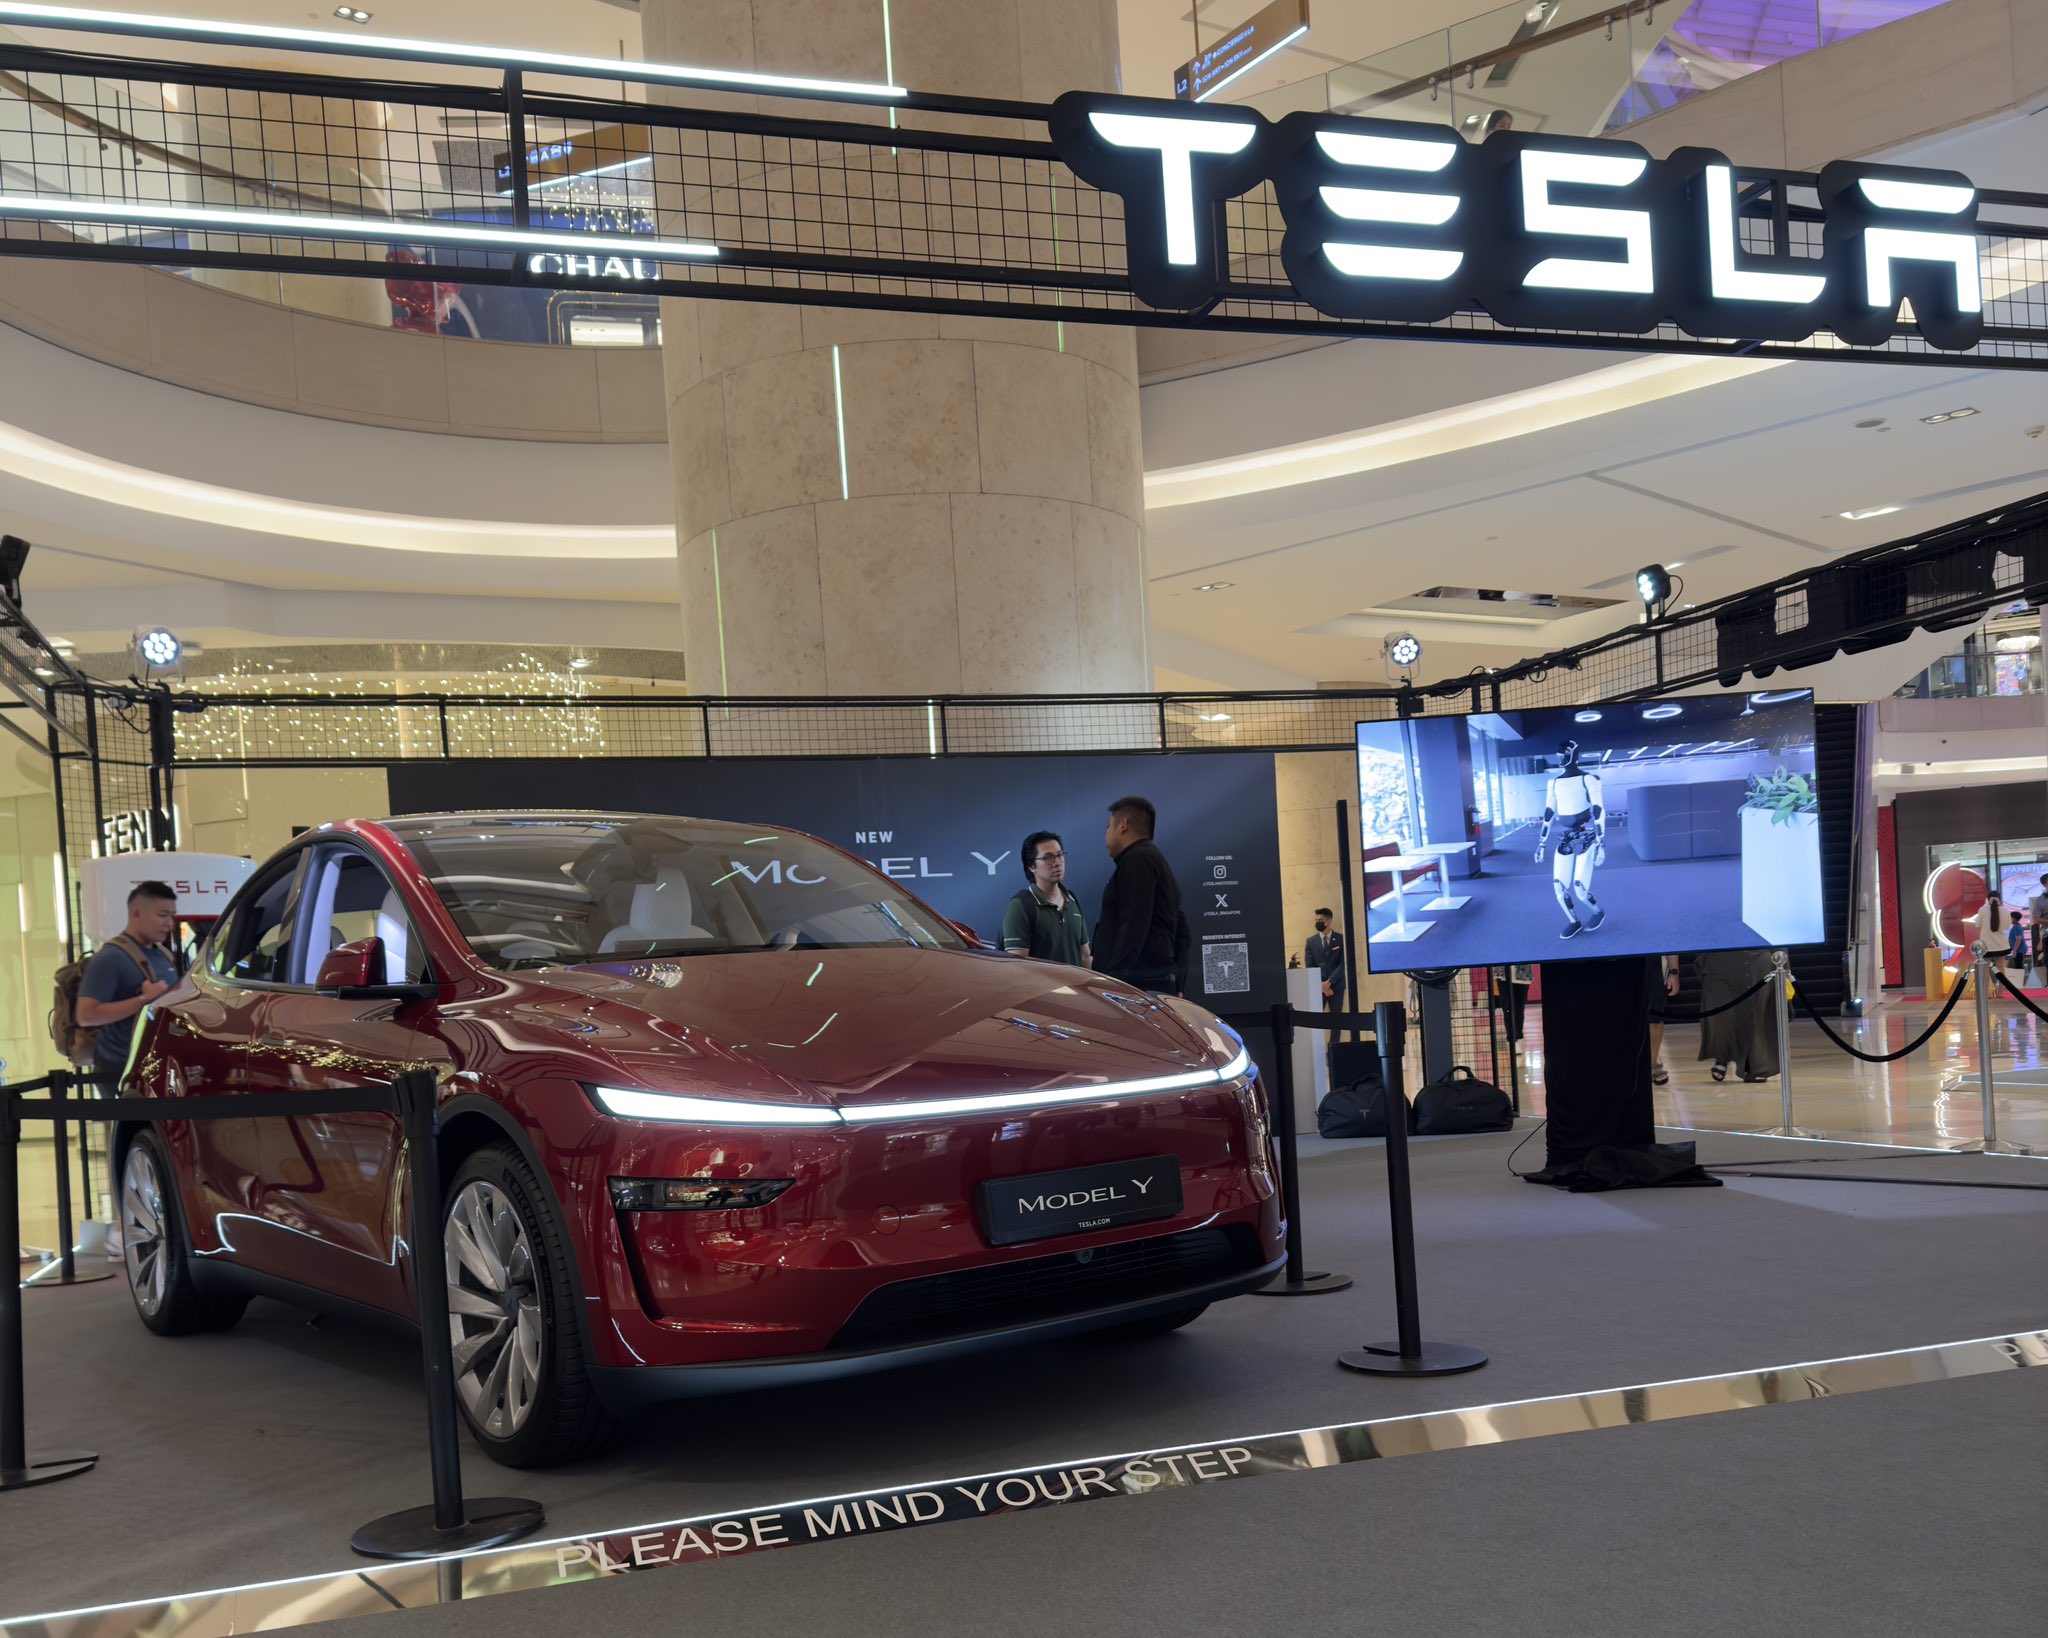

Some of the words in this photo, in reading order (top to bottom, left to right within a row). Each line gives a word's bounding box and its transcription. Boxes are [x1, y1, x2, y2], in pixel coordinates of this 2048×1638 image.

[1177, 79, 1188, 94] L2
[1087, 111, 1982, 313] TESLA
[855, 831, 893, 844] NEW
[730, 857, 953, 884] MOEL
[970, 850, 1011, 876] Y
[1018, 1186, 1126, 1214] MODEL
[1131, 1176, 1154, 1194] Y
[1078, 1217, 1111, 1228] TESLA.COM
[556, 1513, 789, 1578] PLEASE
[803, 1491, 945, 1538] MIND
[955, 1466, 1118, 1512] YOUR
[1124, 1447, 1252, 1488] STEP
